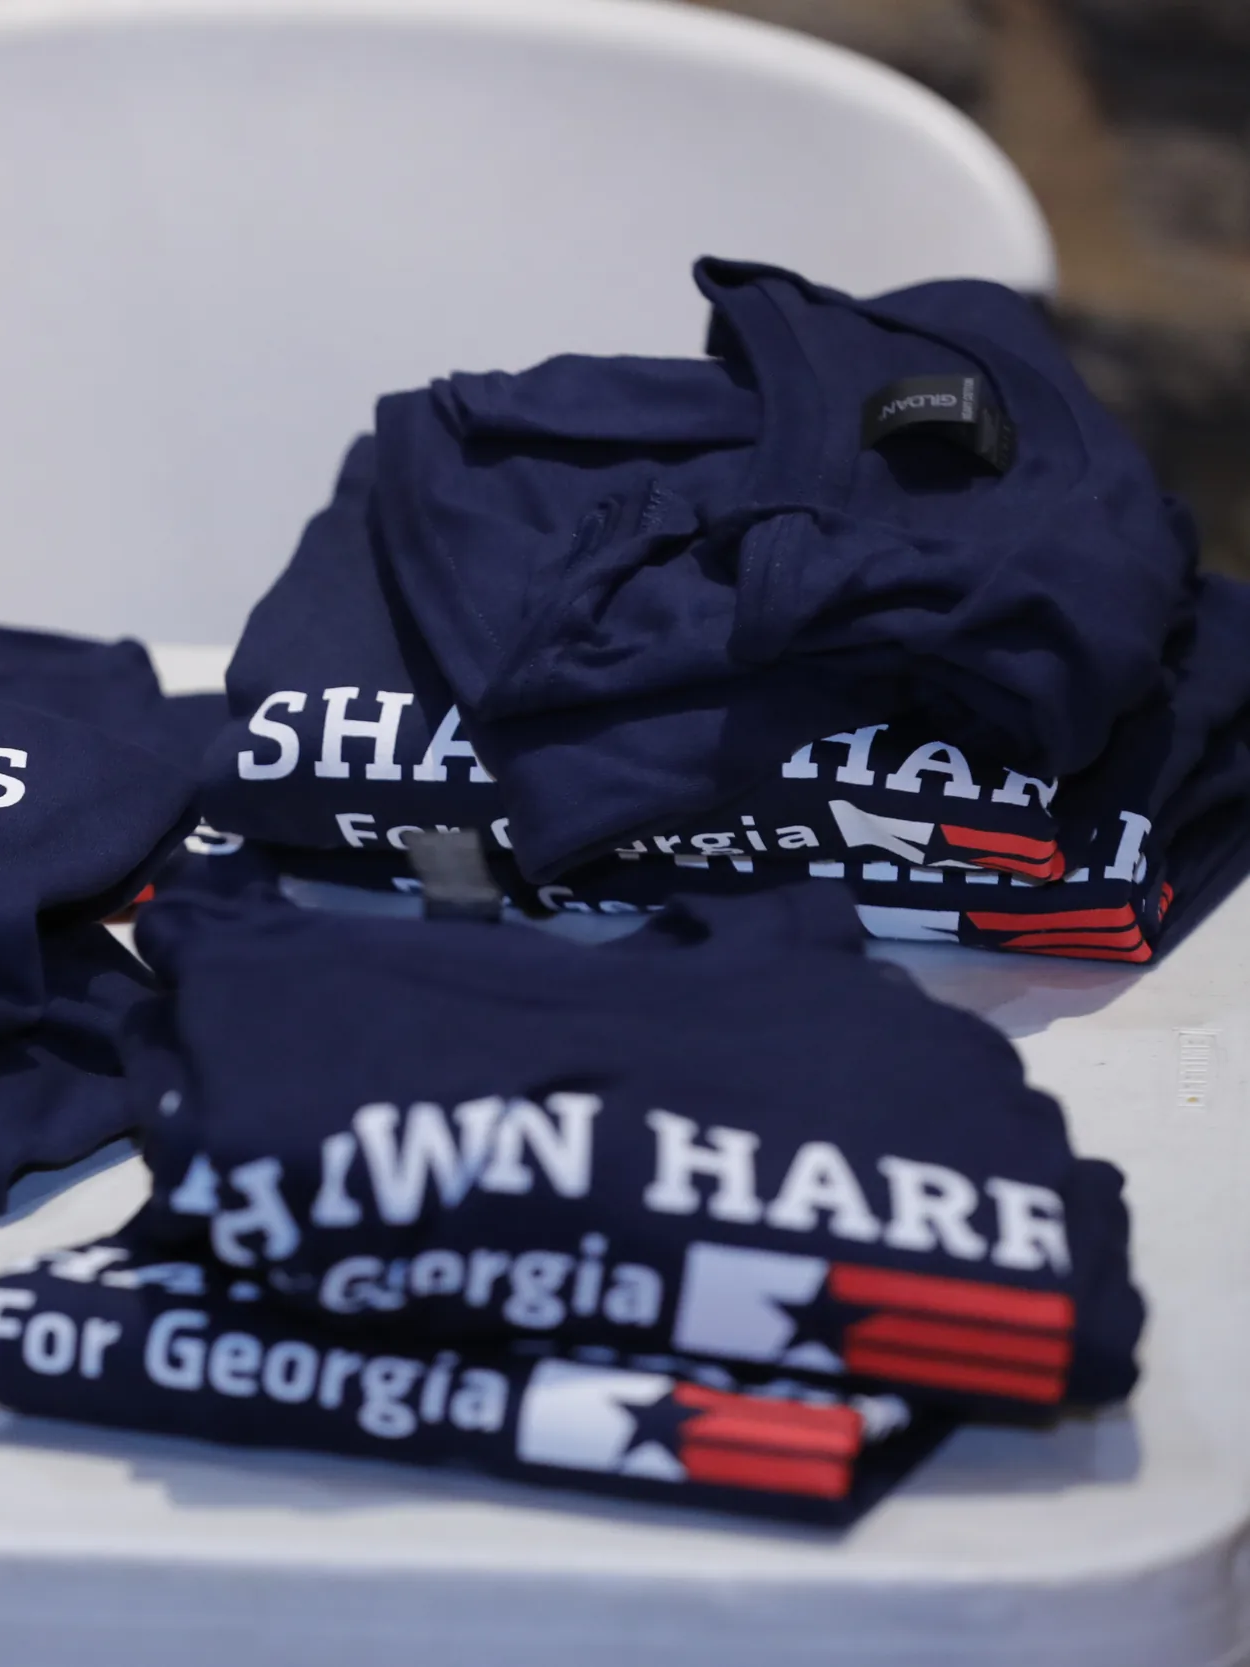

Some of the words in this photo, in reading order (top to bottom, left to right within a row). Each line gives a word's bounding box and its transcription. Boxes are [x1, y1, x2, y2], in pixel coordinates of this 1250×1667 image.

[880, 393, 957, 421] GILDAN
[335, 812, 460, 850] Fo
[144, 1308, 509, 1439] Georgia
